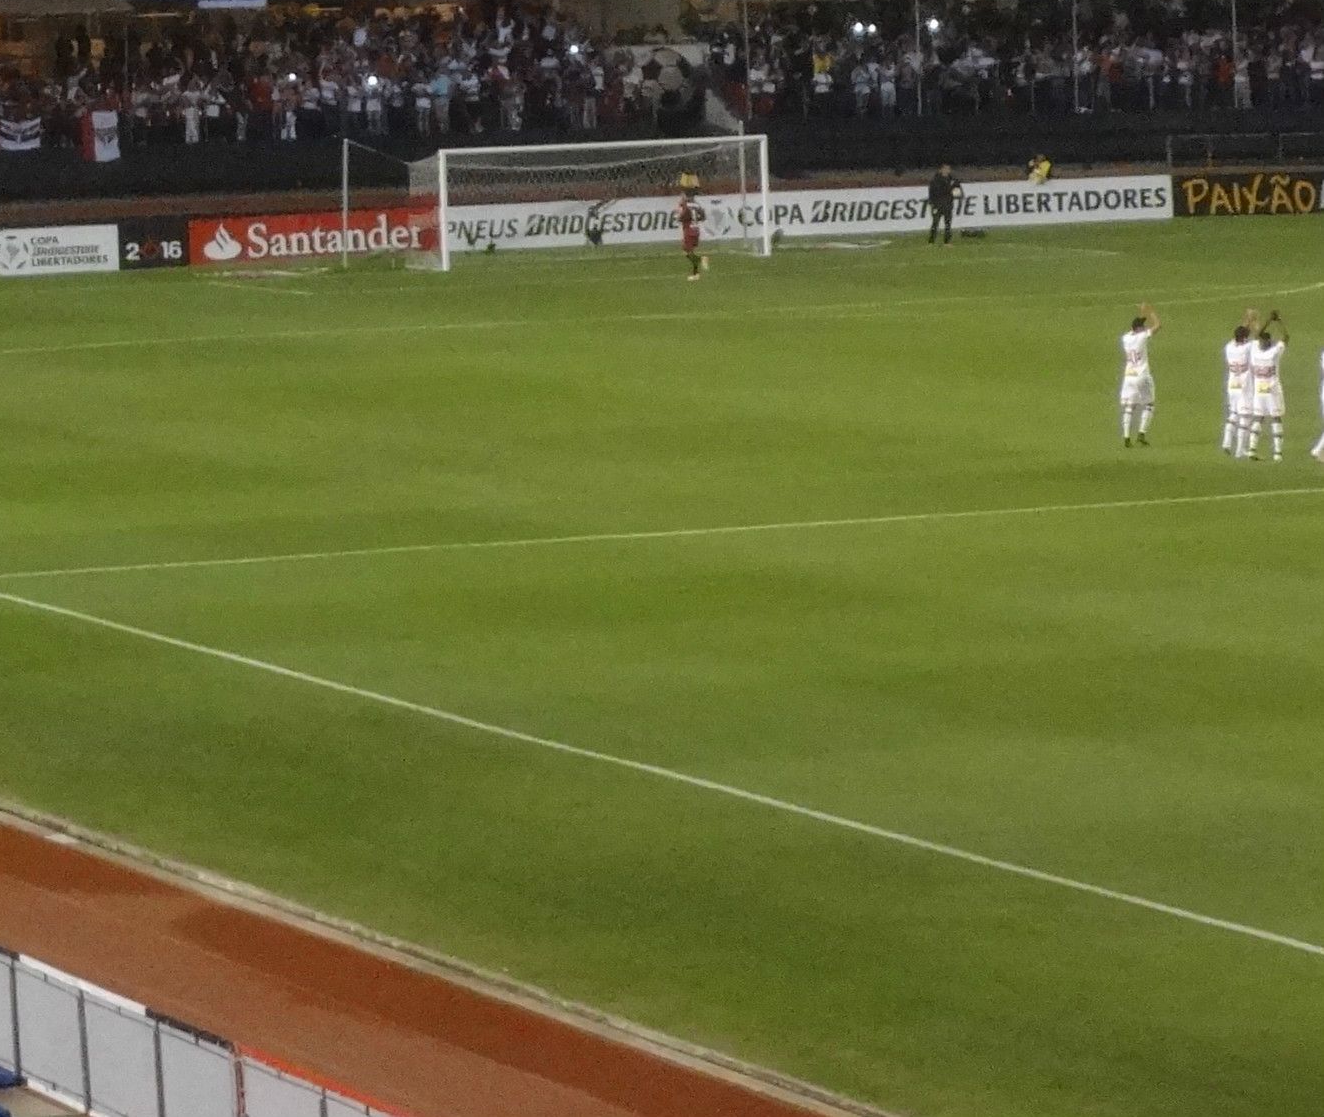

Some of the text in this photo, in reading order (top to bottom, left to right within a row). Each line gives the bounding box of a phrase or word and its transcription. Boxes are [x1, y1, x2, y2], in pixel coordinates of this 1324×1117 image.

[738, 203, 805, 226] COPA
[983, 186, 1167, 215] LIBERTADORES
[30, 235, 60, 245] COPA
[247, 213, 422, 259] Santander
[447, 218, 519, 240] PNEUS
[524, 210, 680, 238] BRIDGESTONE
[31, 255, 109, 267] LIBERTADORES
